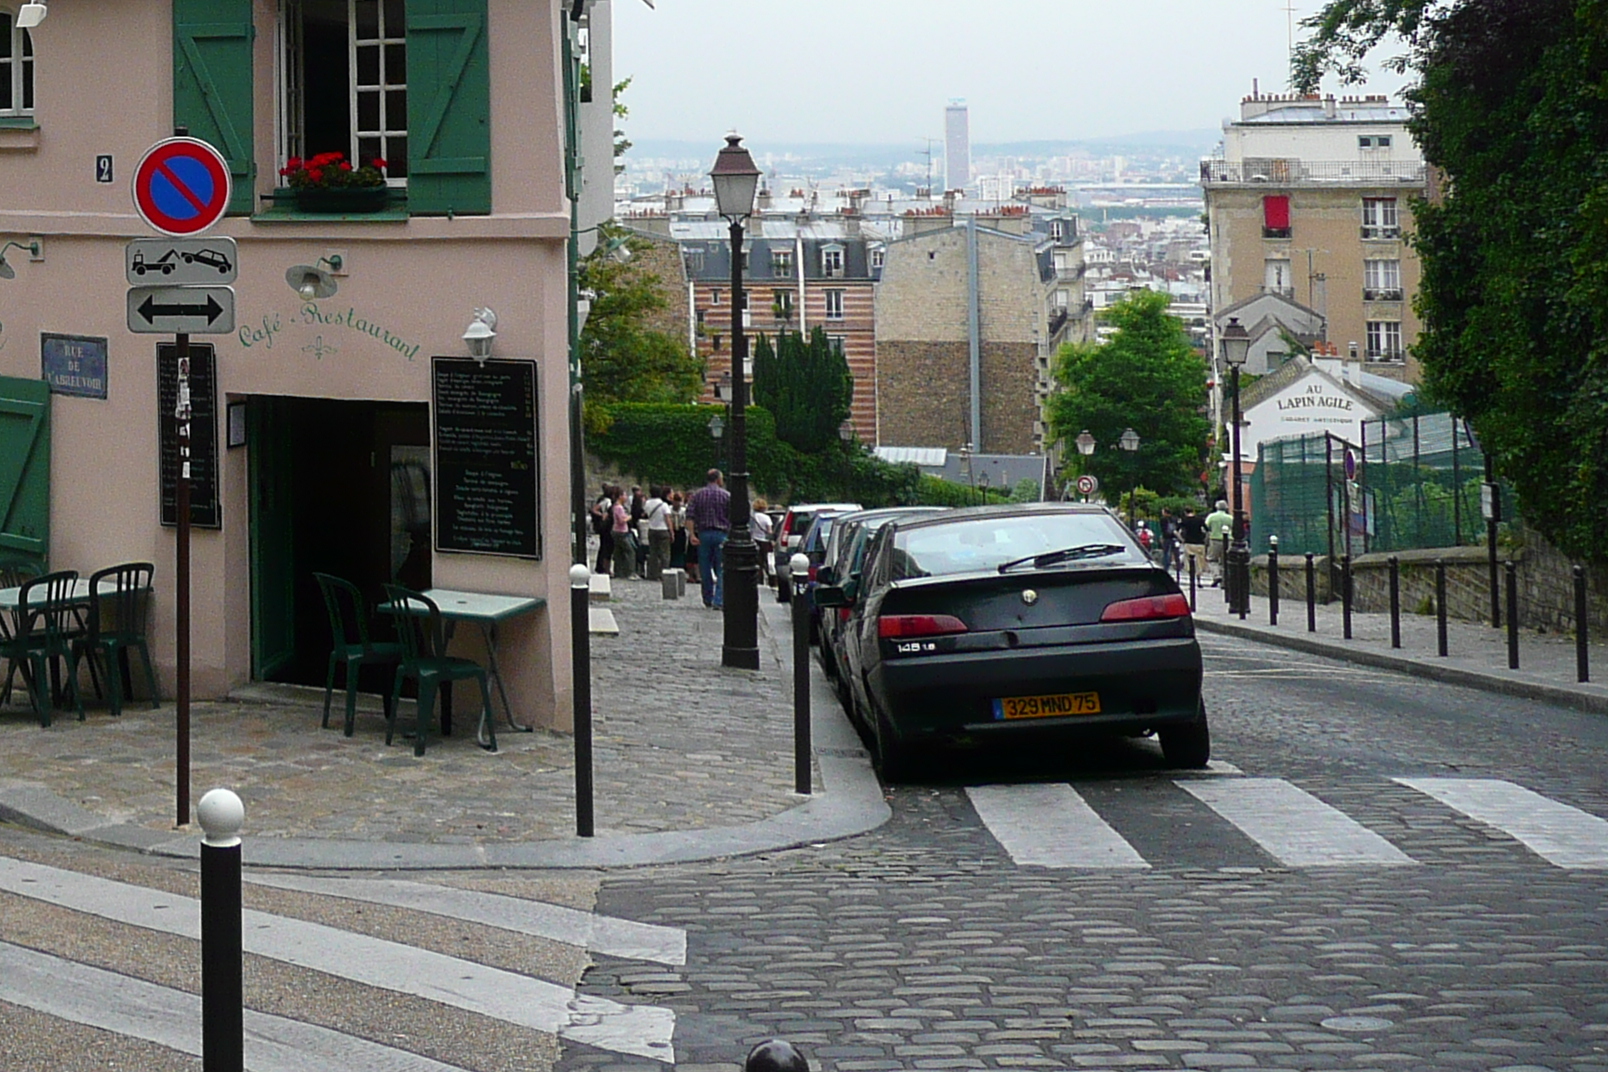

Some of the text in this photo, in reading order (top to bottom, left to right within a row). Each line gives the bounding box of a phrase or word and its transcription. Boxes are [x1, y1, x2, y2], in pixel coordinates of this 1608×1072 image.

[99, 157, 110, 181] 2
[239, 302, 420, 362] Café Restaurant
[64, 345, 84, 358] RUE
[68, 361, 80, 371] DE
[47, 373, 101, 389] L'ABREUVOIR
[1306, 385, 1322, 394] AU
[1277, 396, 1354, 411] LAPIN AGILE
[1007, 694, 1096, 716] 329 MND 75
